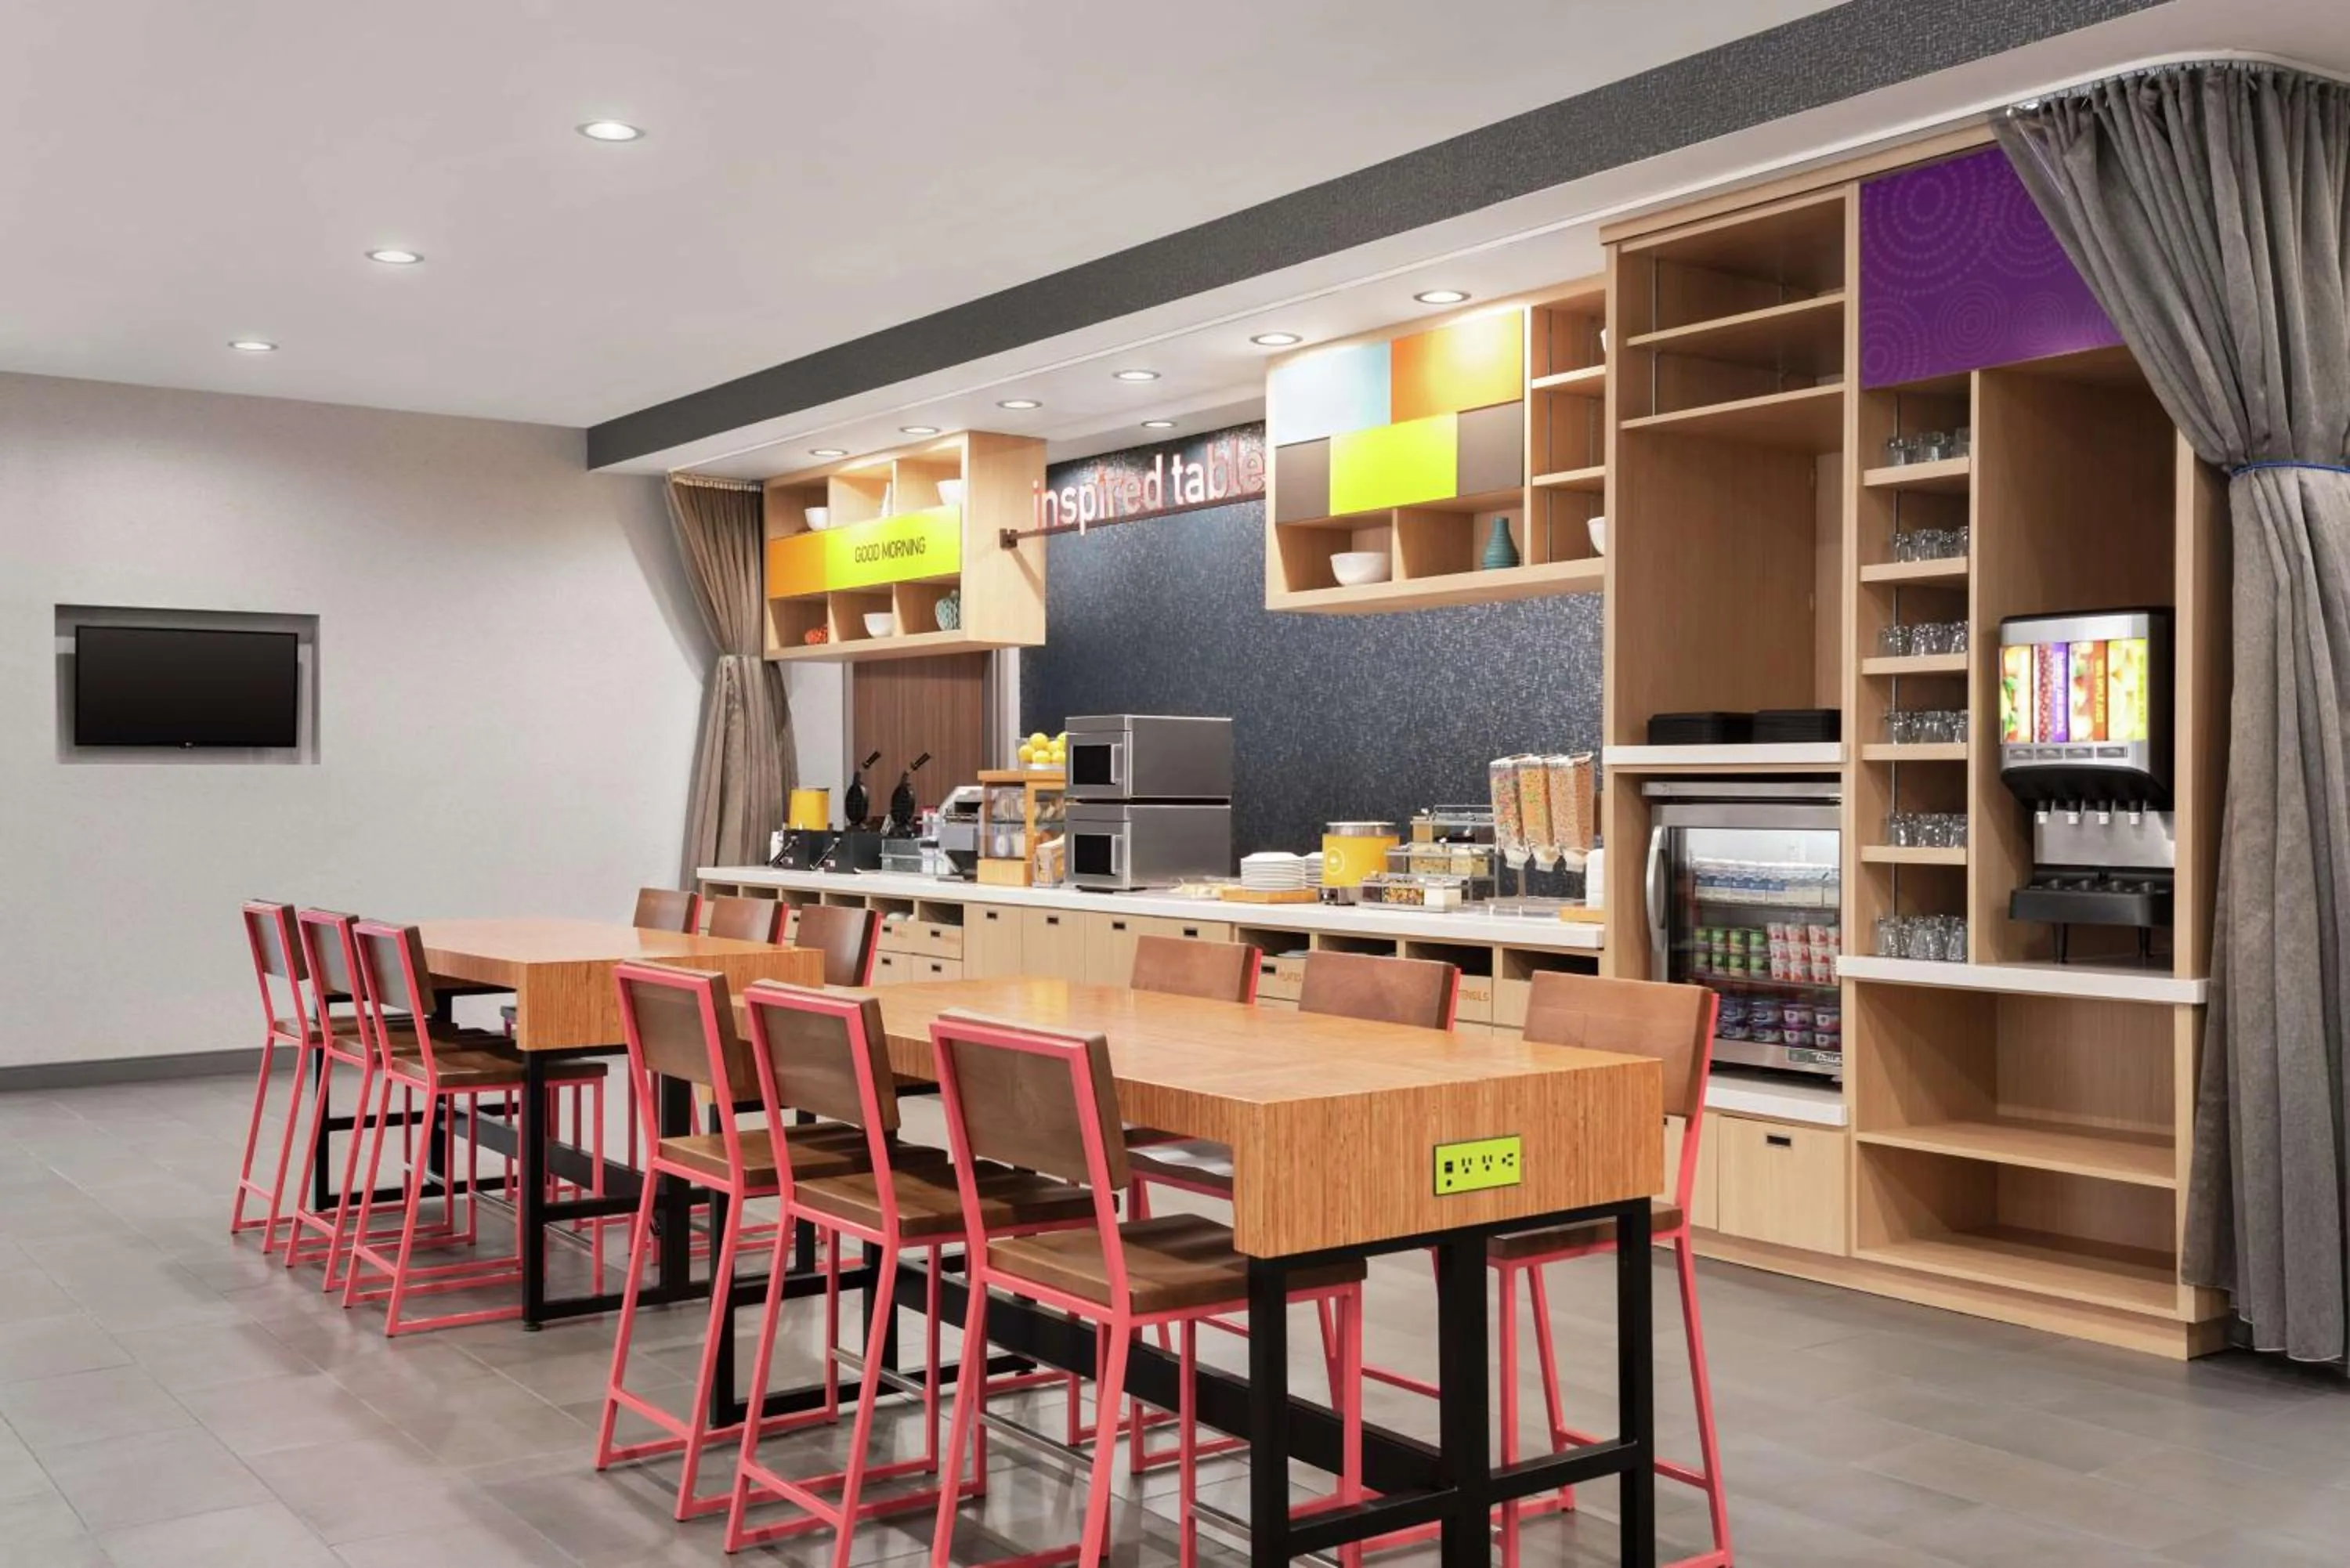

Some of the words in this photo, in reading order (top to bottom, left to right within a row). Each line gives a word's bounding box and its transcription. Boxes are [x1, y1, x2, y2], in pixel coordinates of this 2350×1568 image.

[1032, 453, 1163, 536] inspired
[1171, 435, 1266, 505] table
[855, 543, 880, 563] GOOD
[881, 536, 926, 560] MORNING
